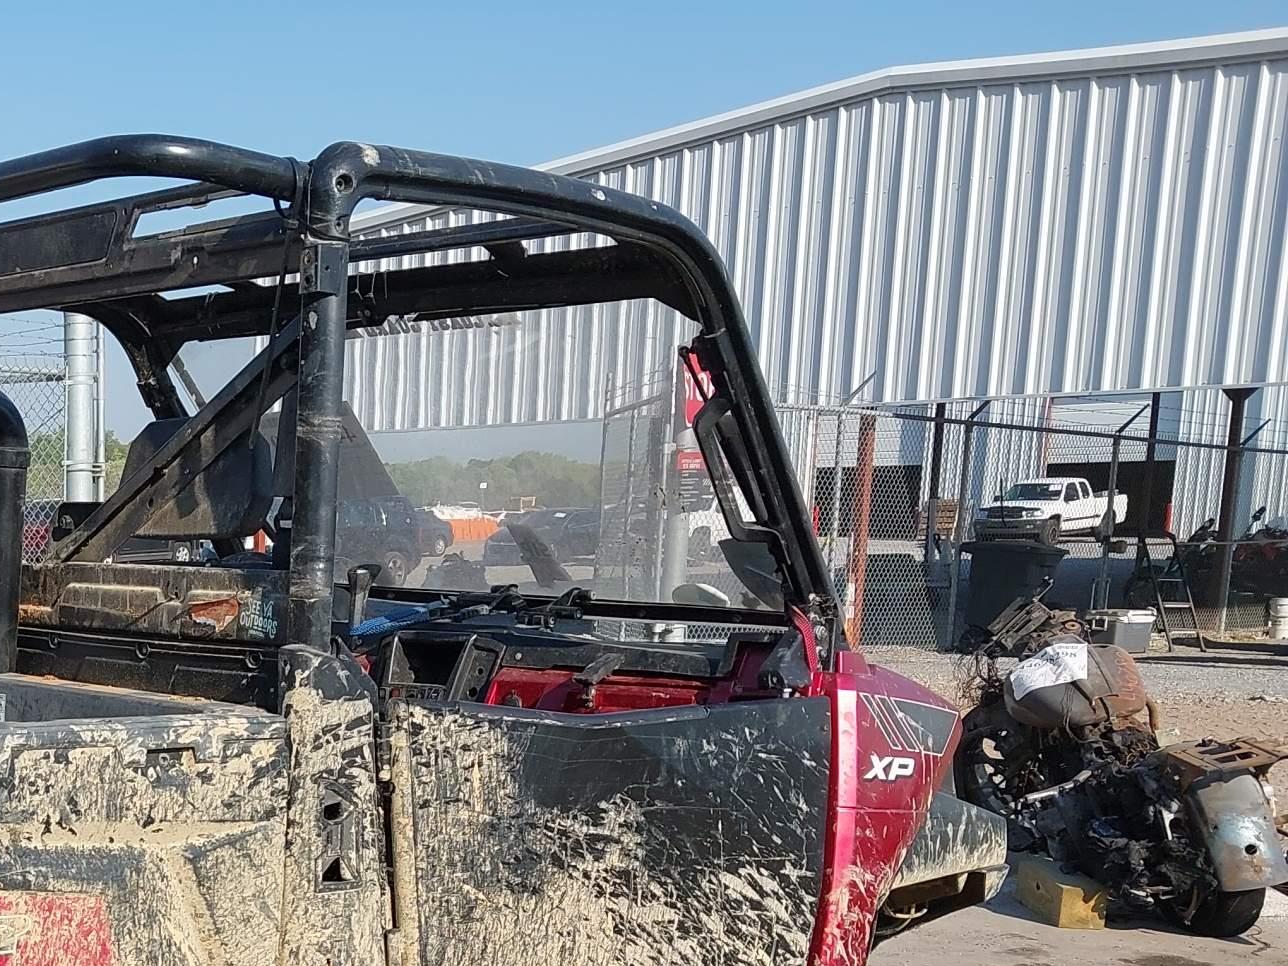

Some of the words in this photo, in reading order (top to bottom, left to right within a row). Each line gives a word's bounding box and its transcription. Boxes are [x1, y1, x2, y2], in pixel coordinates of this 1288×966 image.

[245, 598, 261, 615] SEE
[263, 601, 274, 618] YA
[239, 611, 278, 639] OUTDOORS
[863, 753, 915, 781] XP
